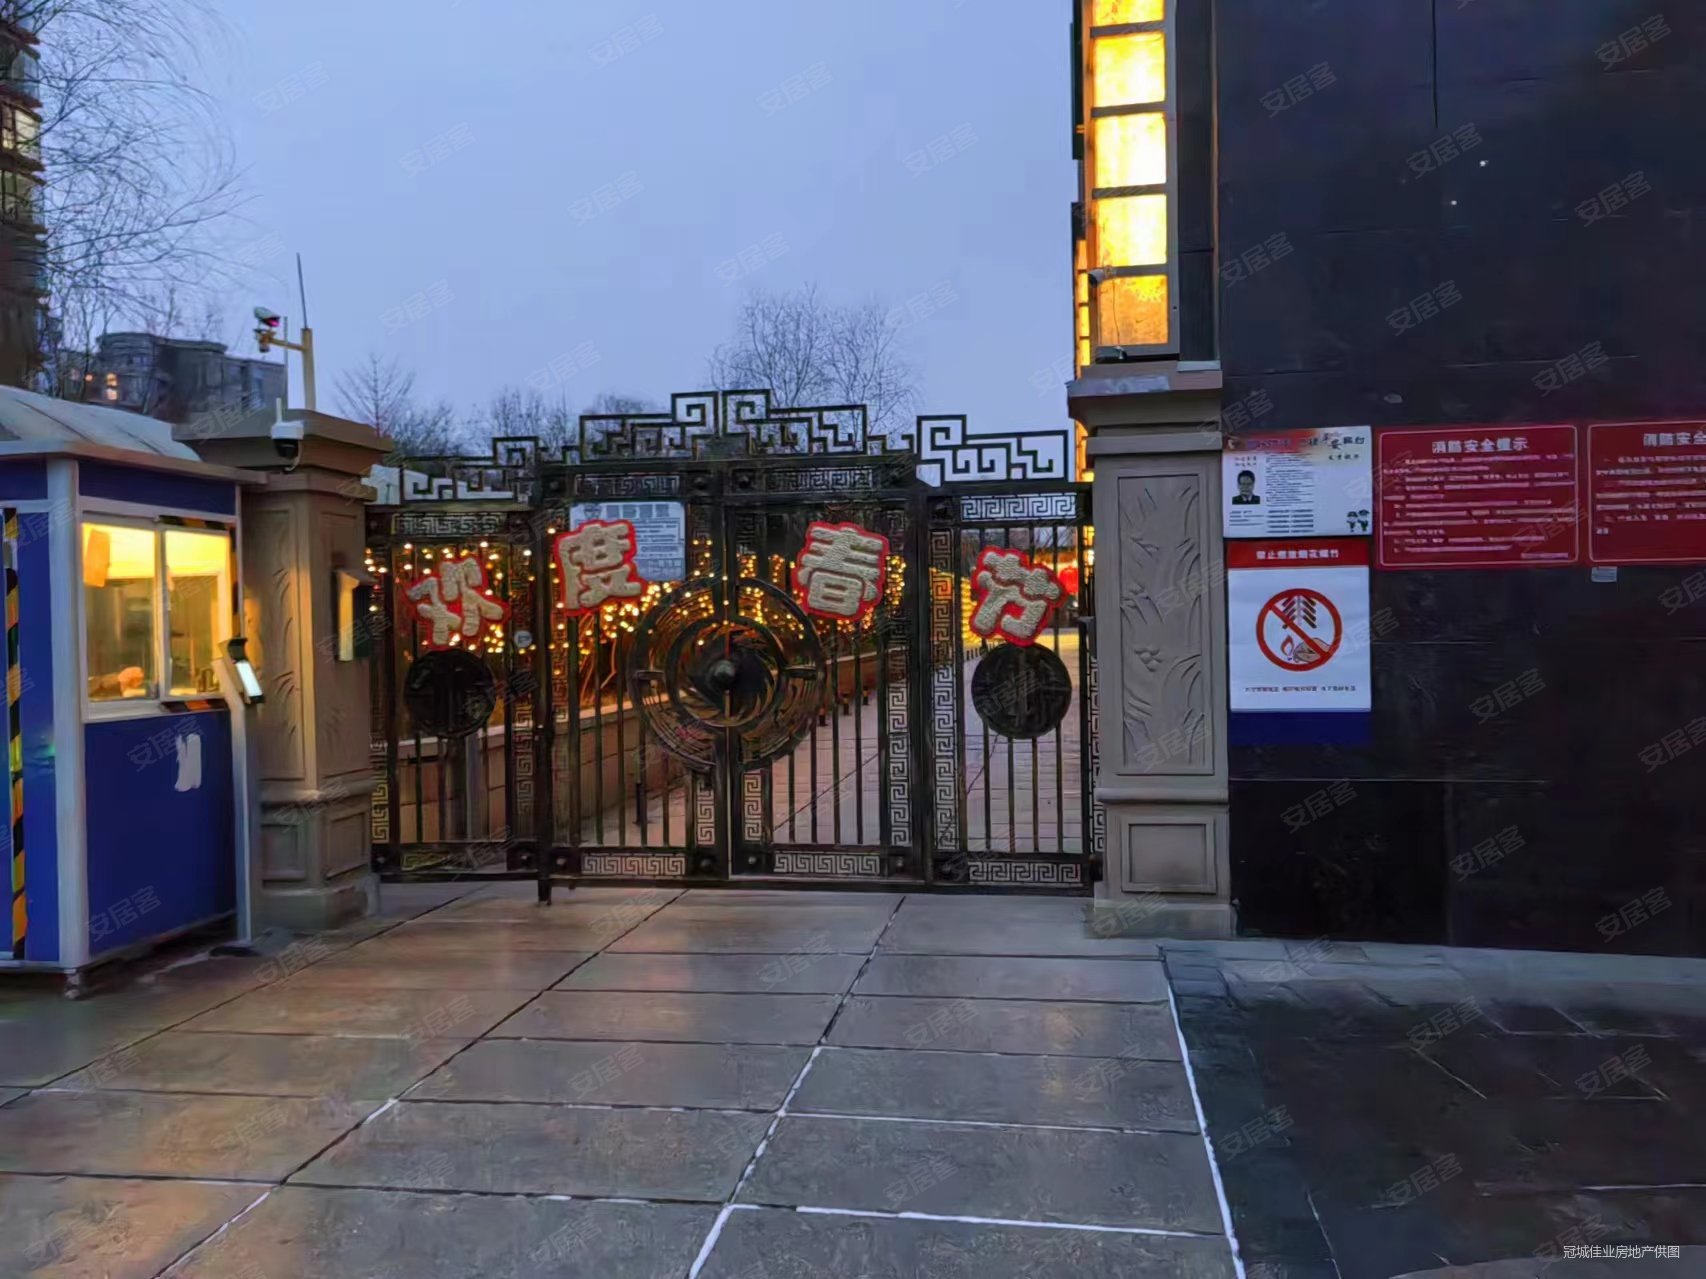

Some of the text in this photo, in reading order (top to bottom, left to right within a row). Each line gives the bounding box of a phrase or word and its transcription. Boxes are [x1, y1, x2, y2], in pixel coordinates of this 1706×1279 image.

[1432, 437, 1529, 454] 消防安全提示
[407, 557, 504, 646] 欢
[558, 523, 643, 609] 度
[797, 526, 881, 616] 春
[974, 551, 1061, 638] 节
